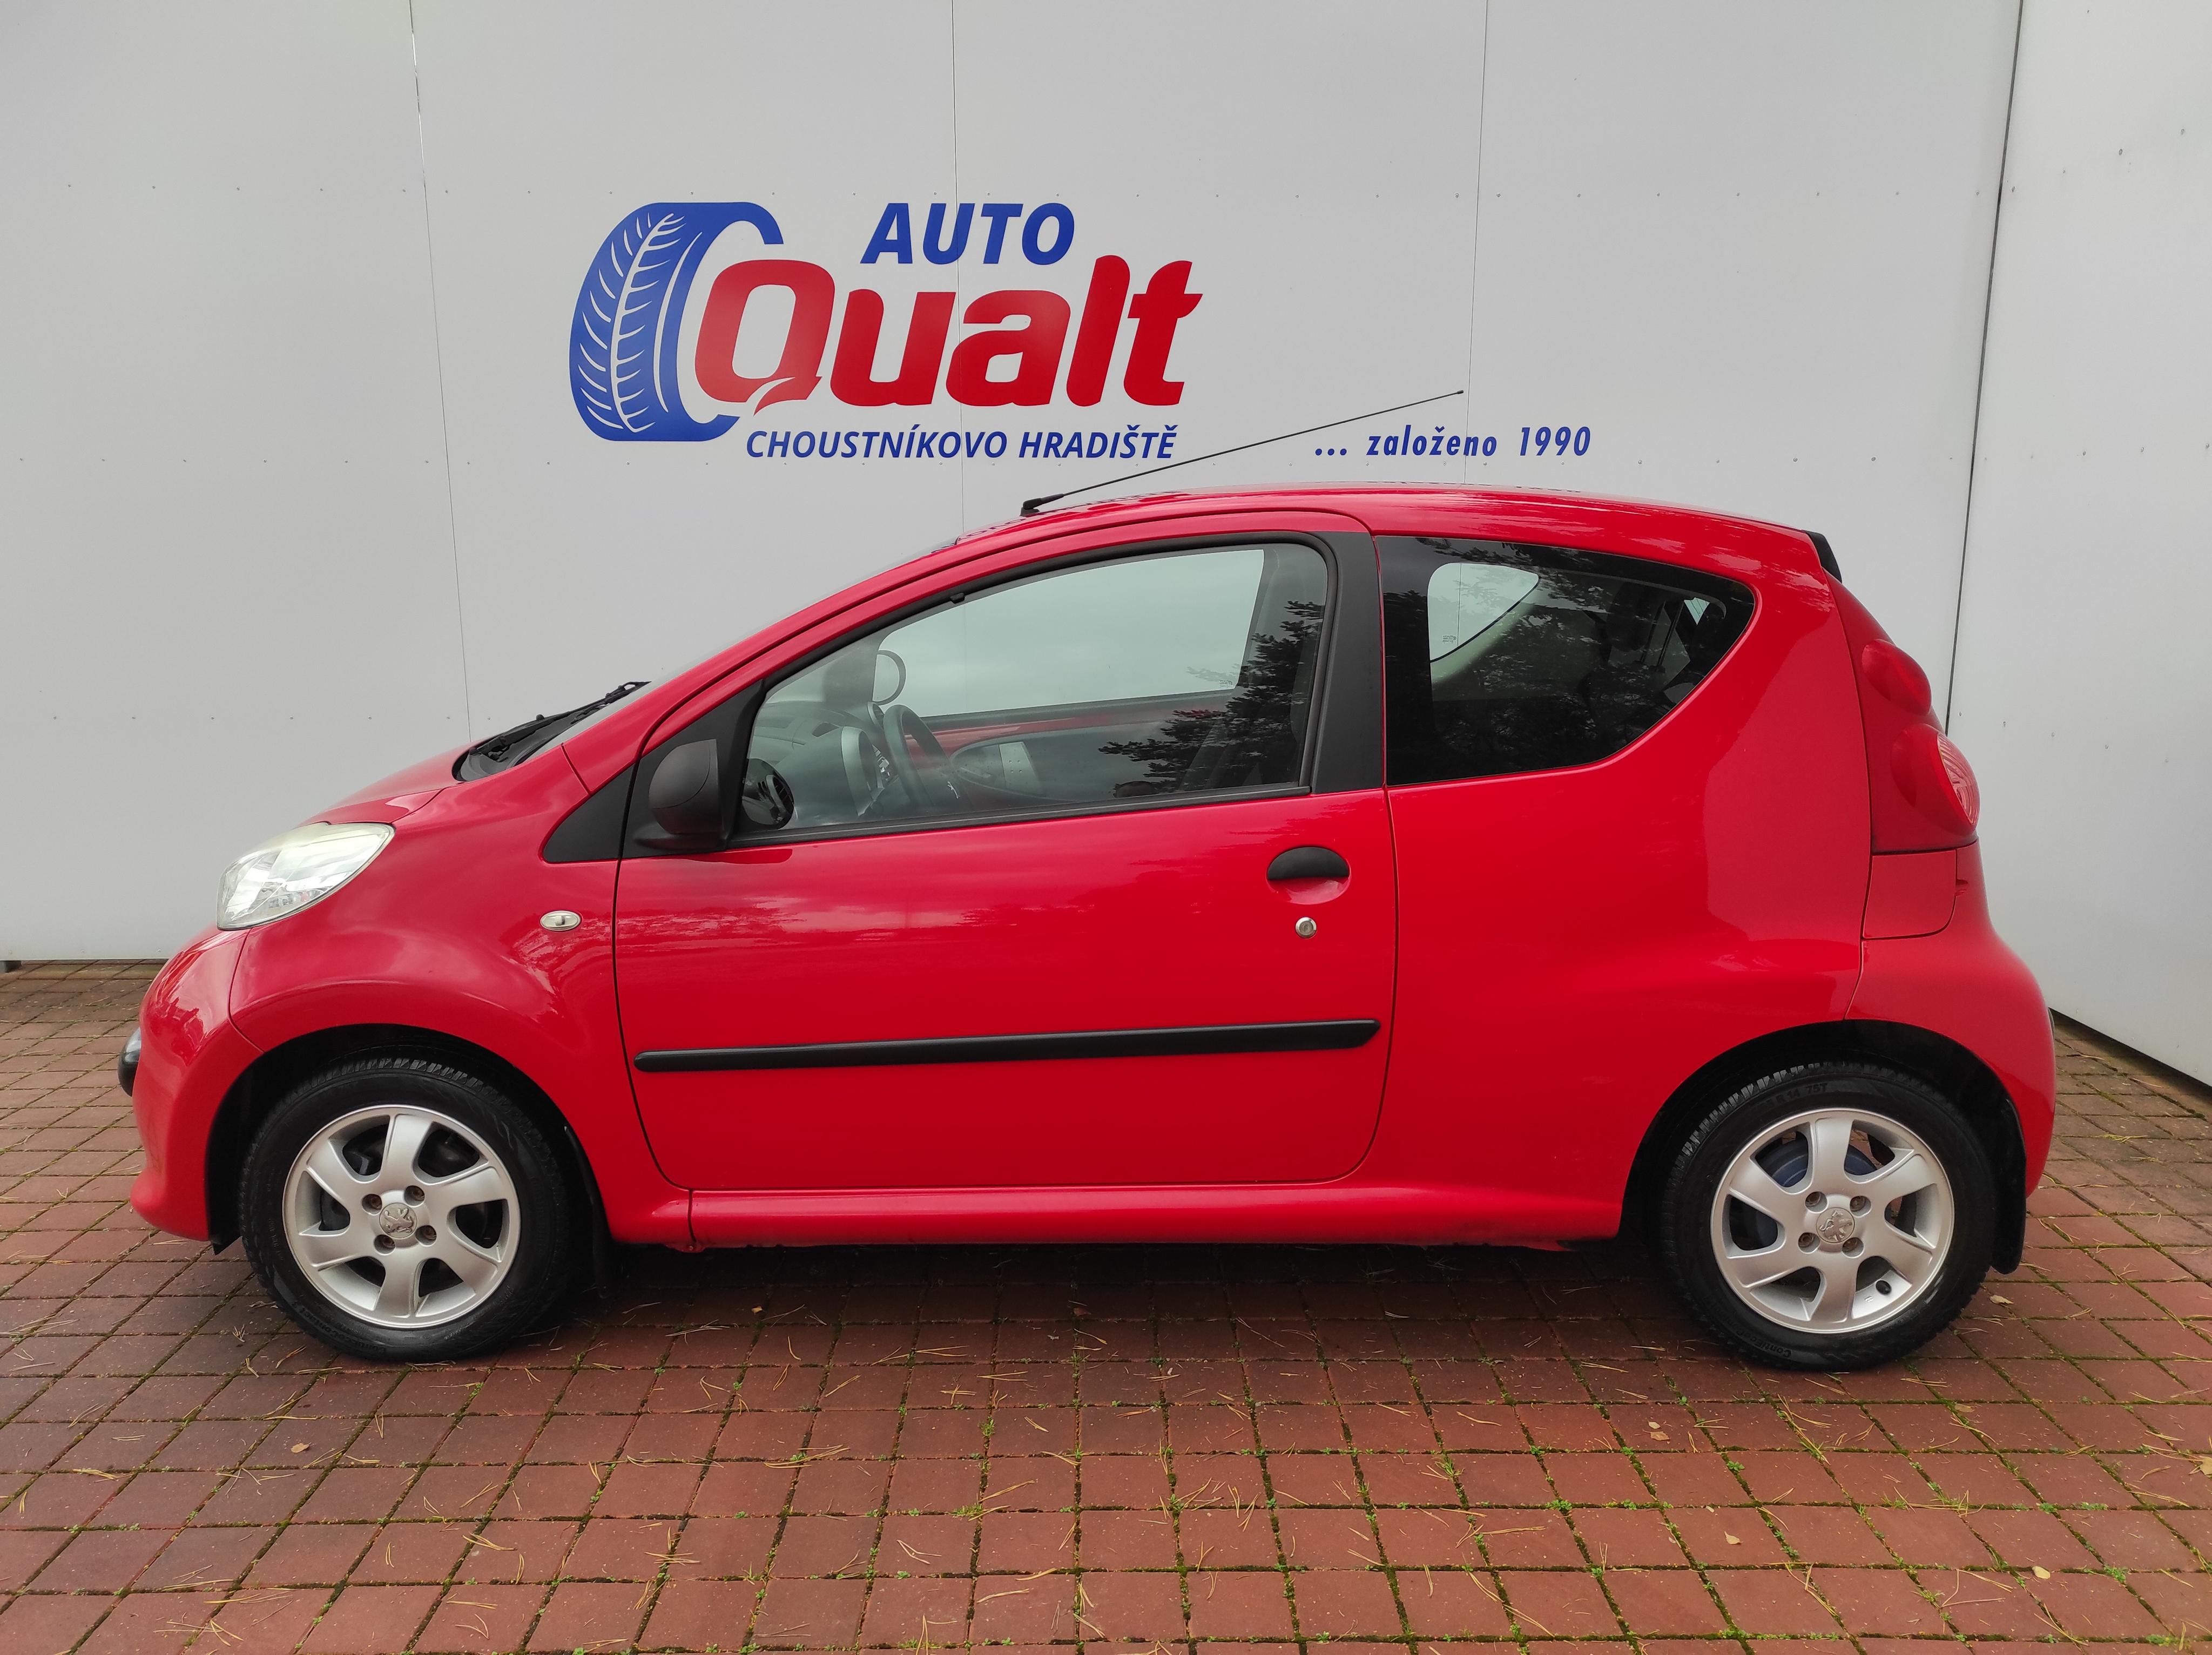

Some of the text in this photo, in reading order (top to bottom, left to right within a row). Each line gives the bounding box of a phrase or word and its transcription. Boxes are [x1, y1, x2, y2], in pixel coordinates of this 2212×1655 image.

[861, 202, 1075, 265] AUTO
[695, 254, 1203, 415] Qualt
[746, 424, 1177, 459] CHOUSTNÍKOVO HRADIŠTĚ
[1367, 424, 1498, 457] založeno
[1520, 426, 1590, 456] 1990
